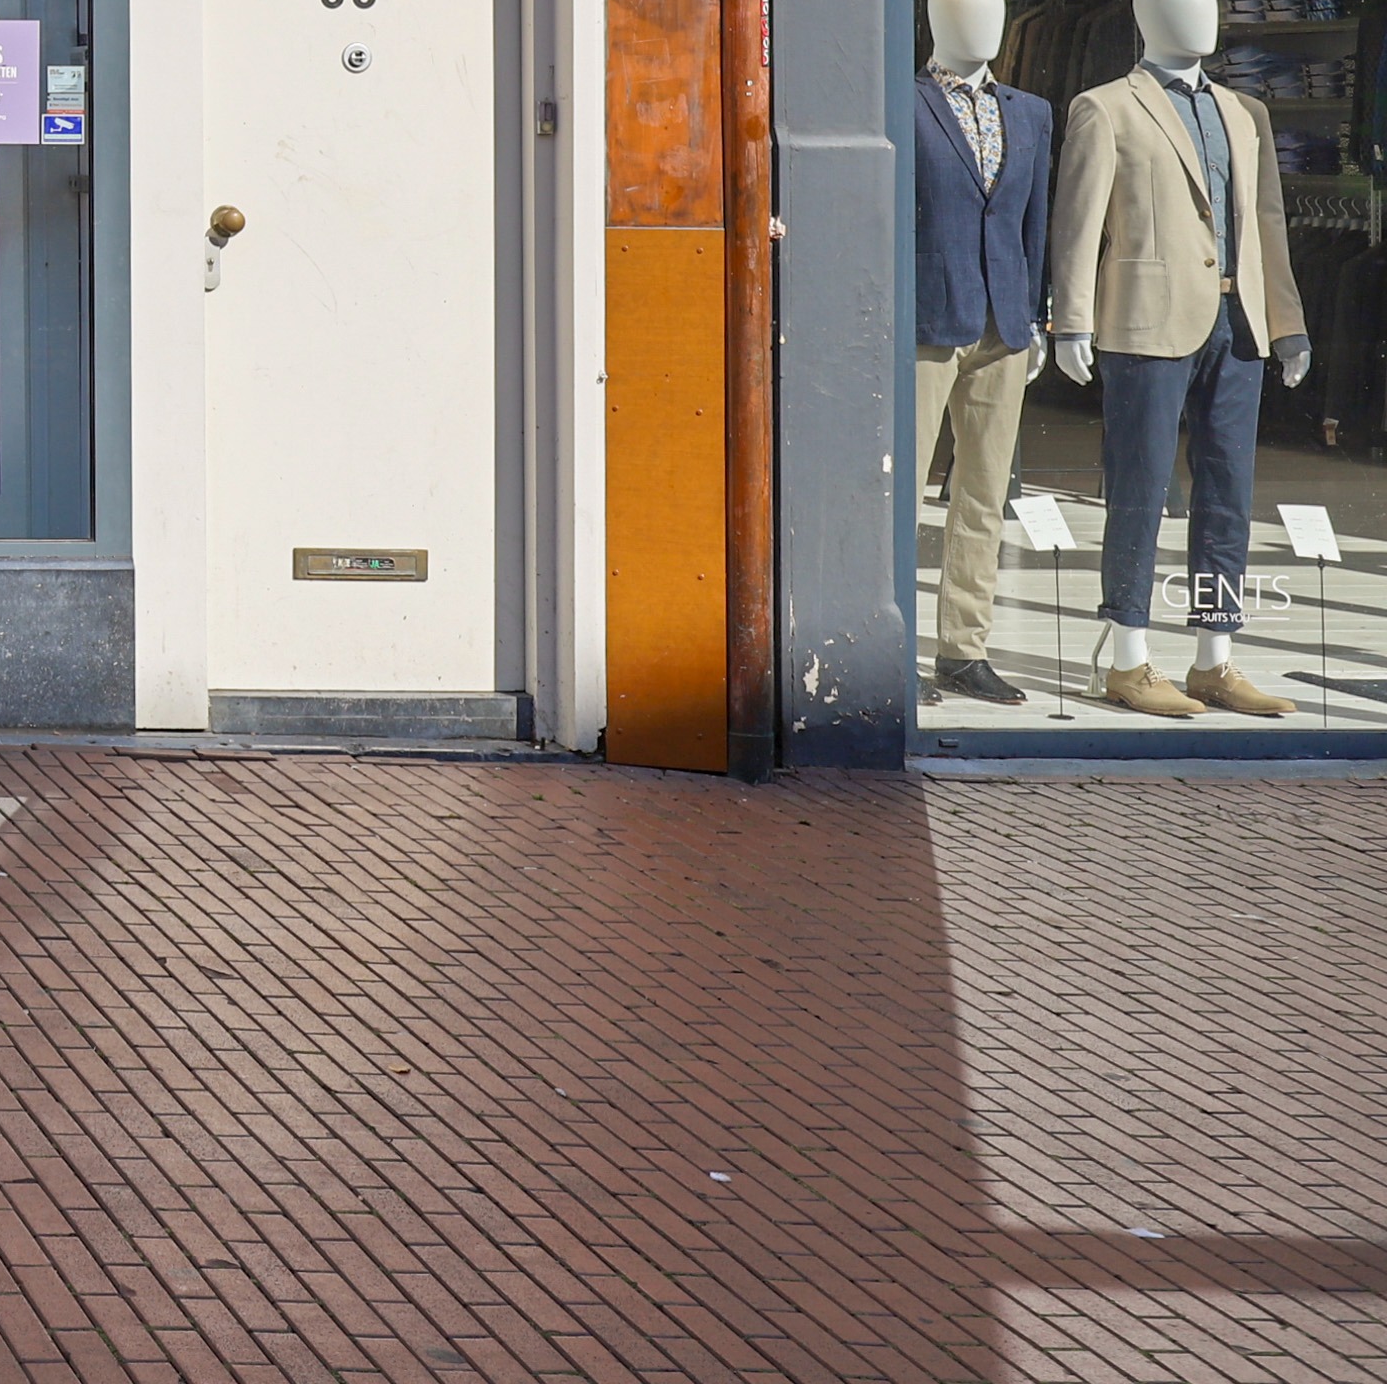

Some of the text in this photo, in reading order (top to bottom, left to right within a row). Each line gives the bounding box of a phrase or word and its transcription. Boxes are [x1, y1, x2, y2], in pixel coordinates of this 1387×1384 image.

[1161, 572, 1292, 611] GENTS
[1201, 612, 1251, 623] SUITS YOU
